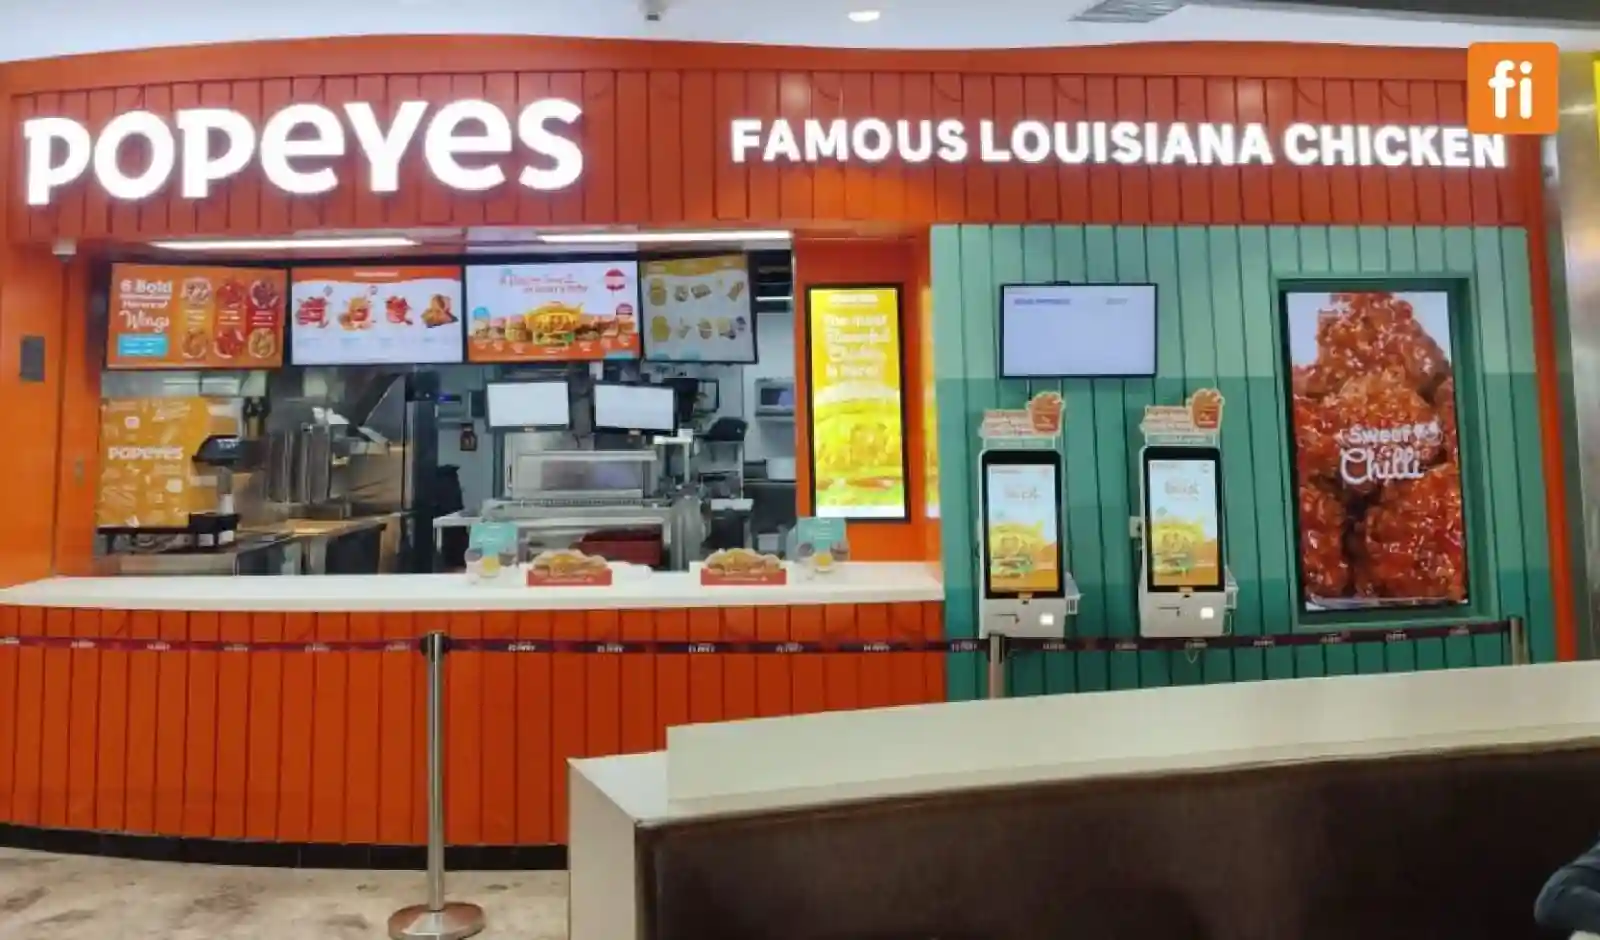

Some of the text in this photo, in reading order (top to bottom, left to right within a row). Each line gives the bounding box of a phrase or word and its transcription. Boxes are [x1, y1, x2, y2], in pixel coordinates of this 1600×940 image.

[731, 118, 1506, 168] FAMOUS LOUISIANA CHICKEN
[120, 279, 173, 293] 6 Bold
[119, 310, 170, 333] Wings
[1341, 446, 1424, 486] Chilli
